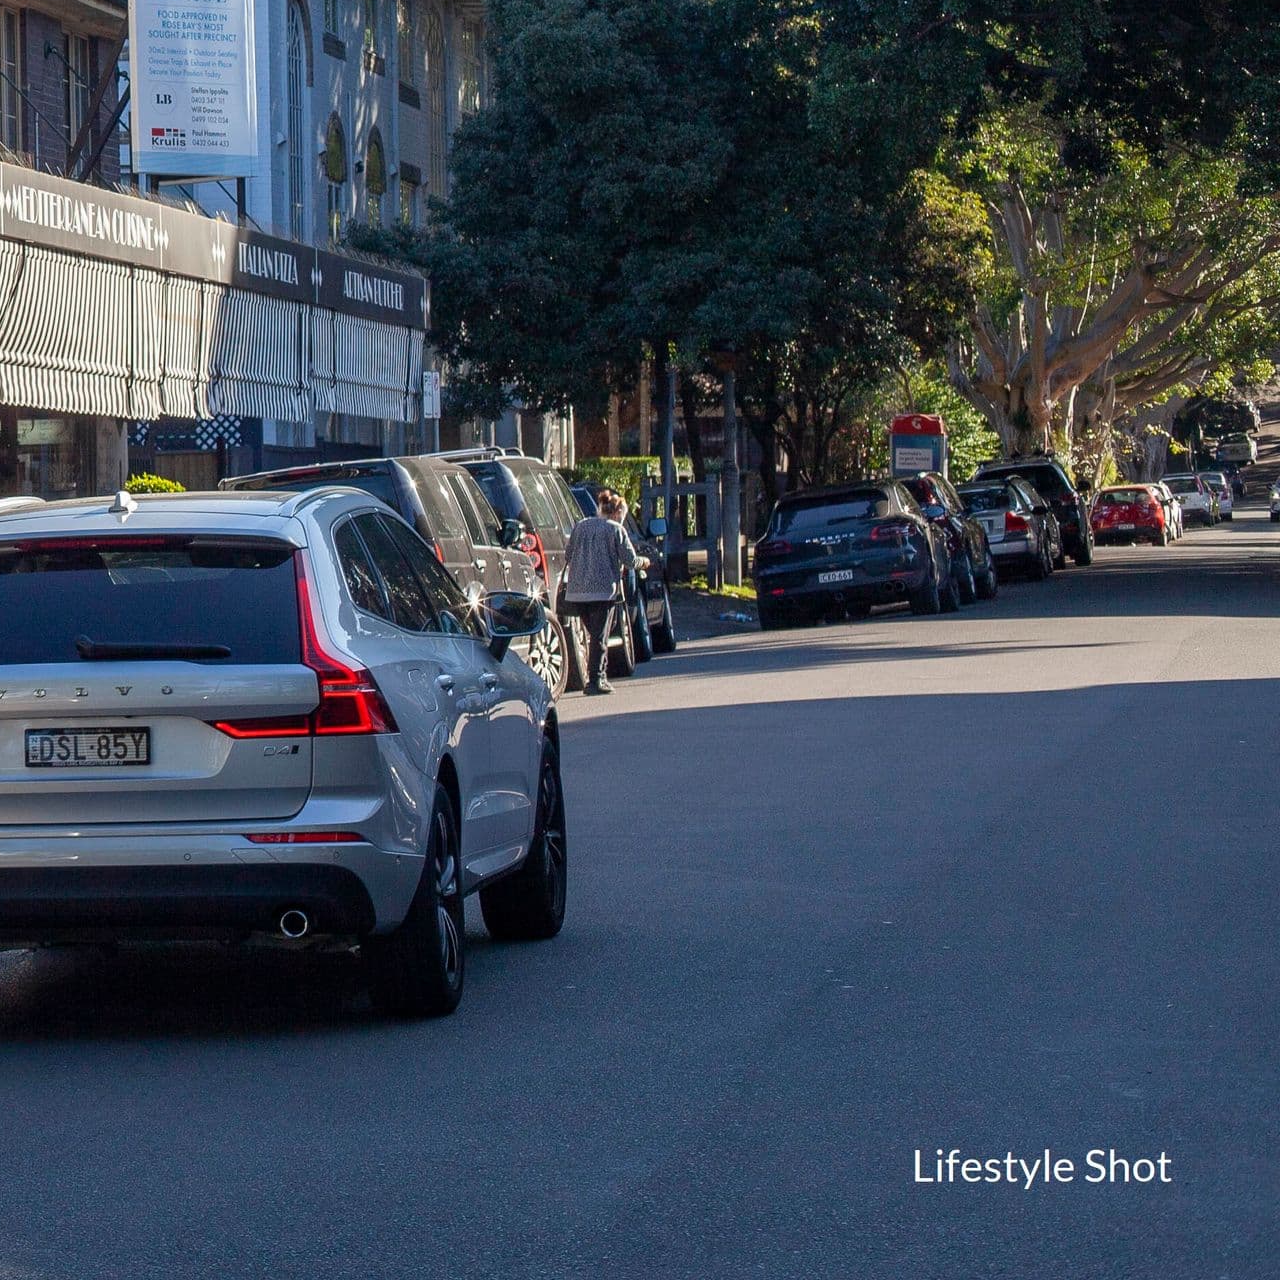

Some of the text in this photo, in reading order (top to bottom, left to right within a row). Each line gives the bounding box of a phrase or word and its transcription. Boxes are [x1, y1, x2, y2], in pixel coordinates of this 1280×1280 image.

[158, 10, 227, 22] FOOD APPROVED IN
[162, 21, 224, 31] ROSE BAY'S MOST
[148, 30, 237, 42] SOUGHT AFTER PRECINCT
[151, 137, 186, 147] Krulis
[11, 183, 155, 251] MEDITERRANEAN CUISINE
[238, 241, 299, 286] ITALIAN PIZZA
[343, 270, 405, 311] ARTISAN BUTCHER
